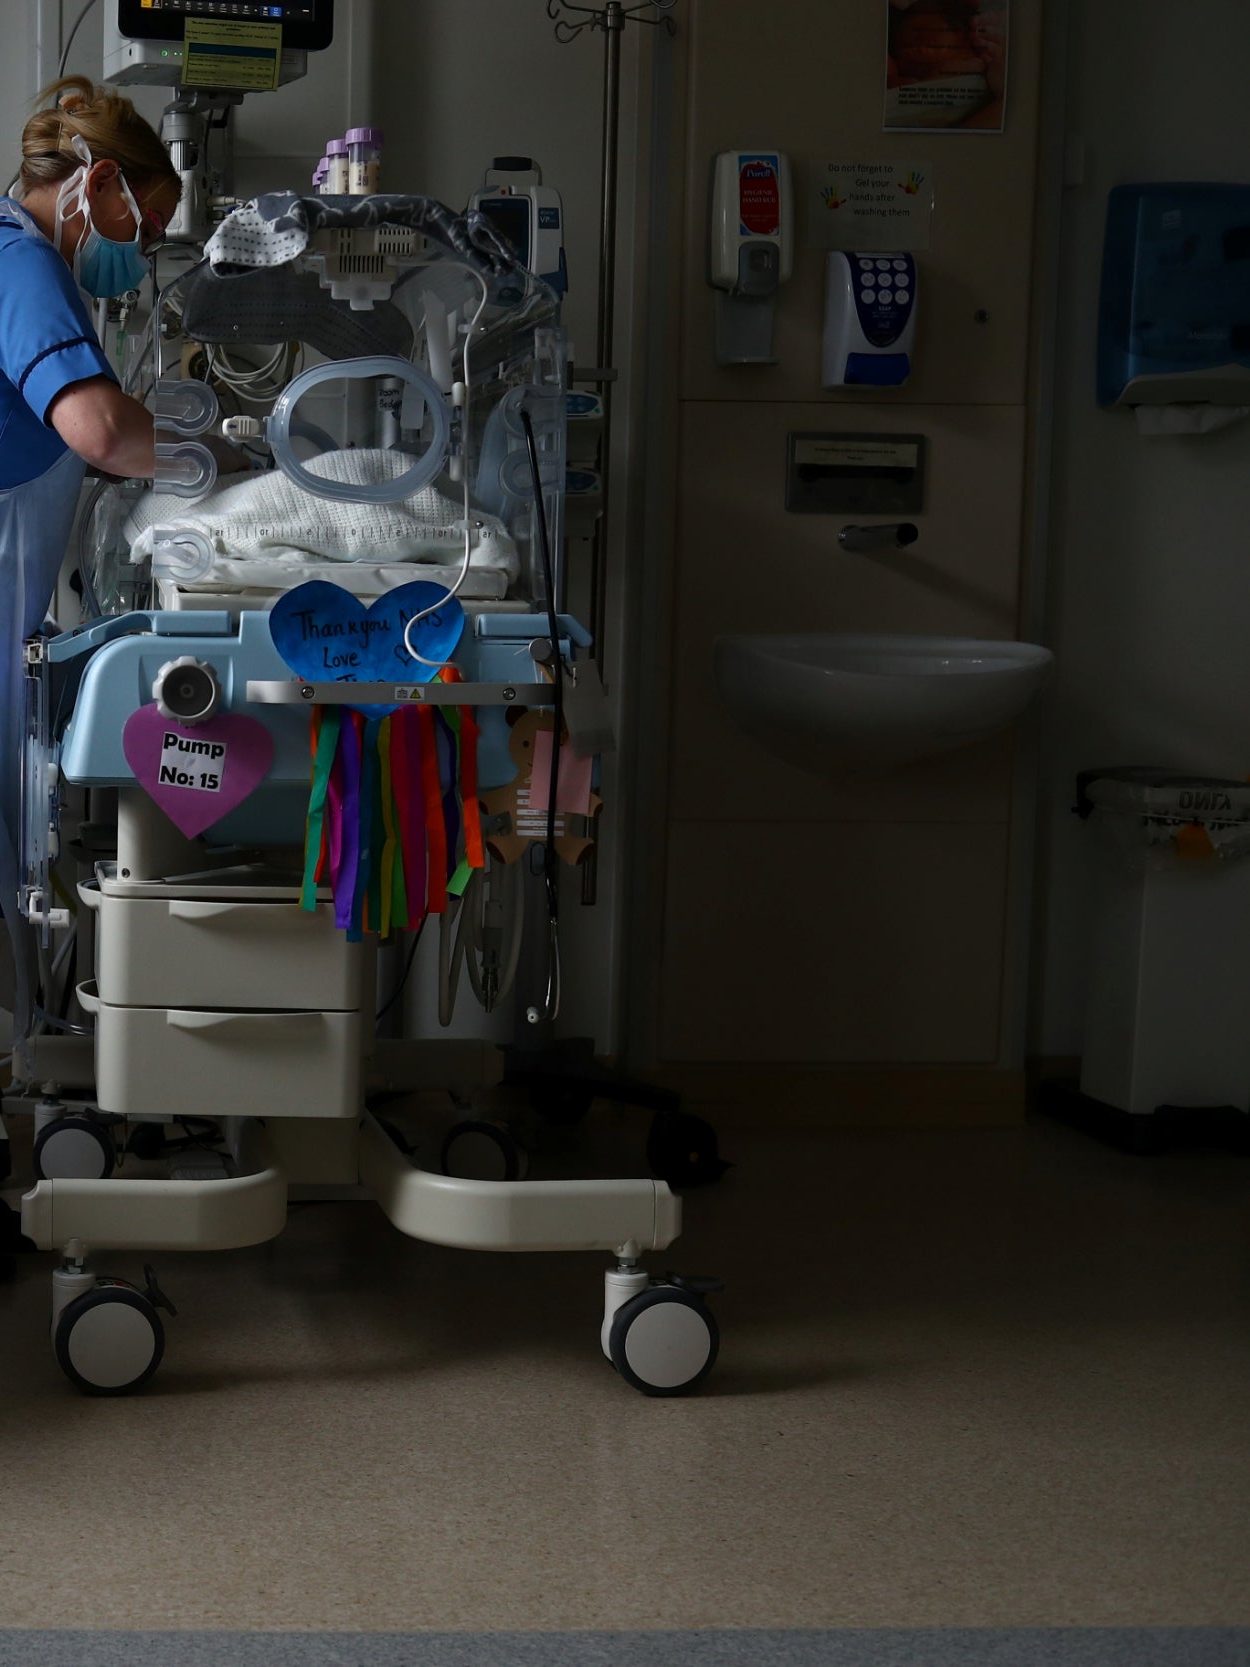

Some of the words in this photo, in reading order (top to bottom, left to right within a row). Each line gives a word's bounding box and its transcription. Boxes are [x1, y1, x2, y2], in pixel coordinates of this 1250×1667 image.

[828, 163, 840, 172] Do
[841, 164, 855, 172] not
[857, 163, 882, 174] forget
[884, 164, 893, 173] to
[855, 178, 869, 187] Gel
[871, 180, 889, 189] your
[849, 192, 874, 202] hands
[876, 192, 895, 202] after
[853, 207, 887, 217] washing
[888, 207, 910, 217] them
[323, 646, 361, 669] Love
[163, 733, 224, 760] Pump
[160, 765, 194, 787] No:
[200, 773, 219, 790] 15
